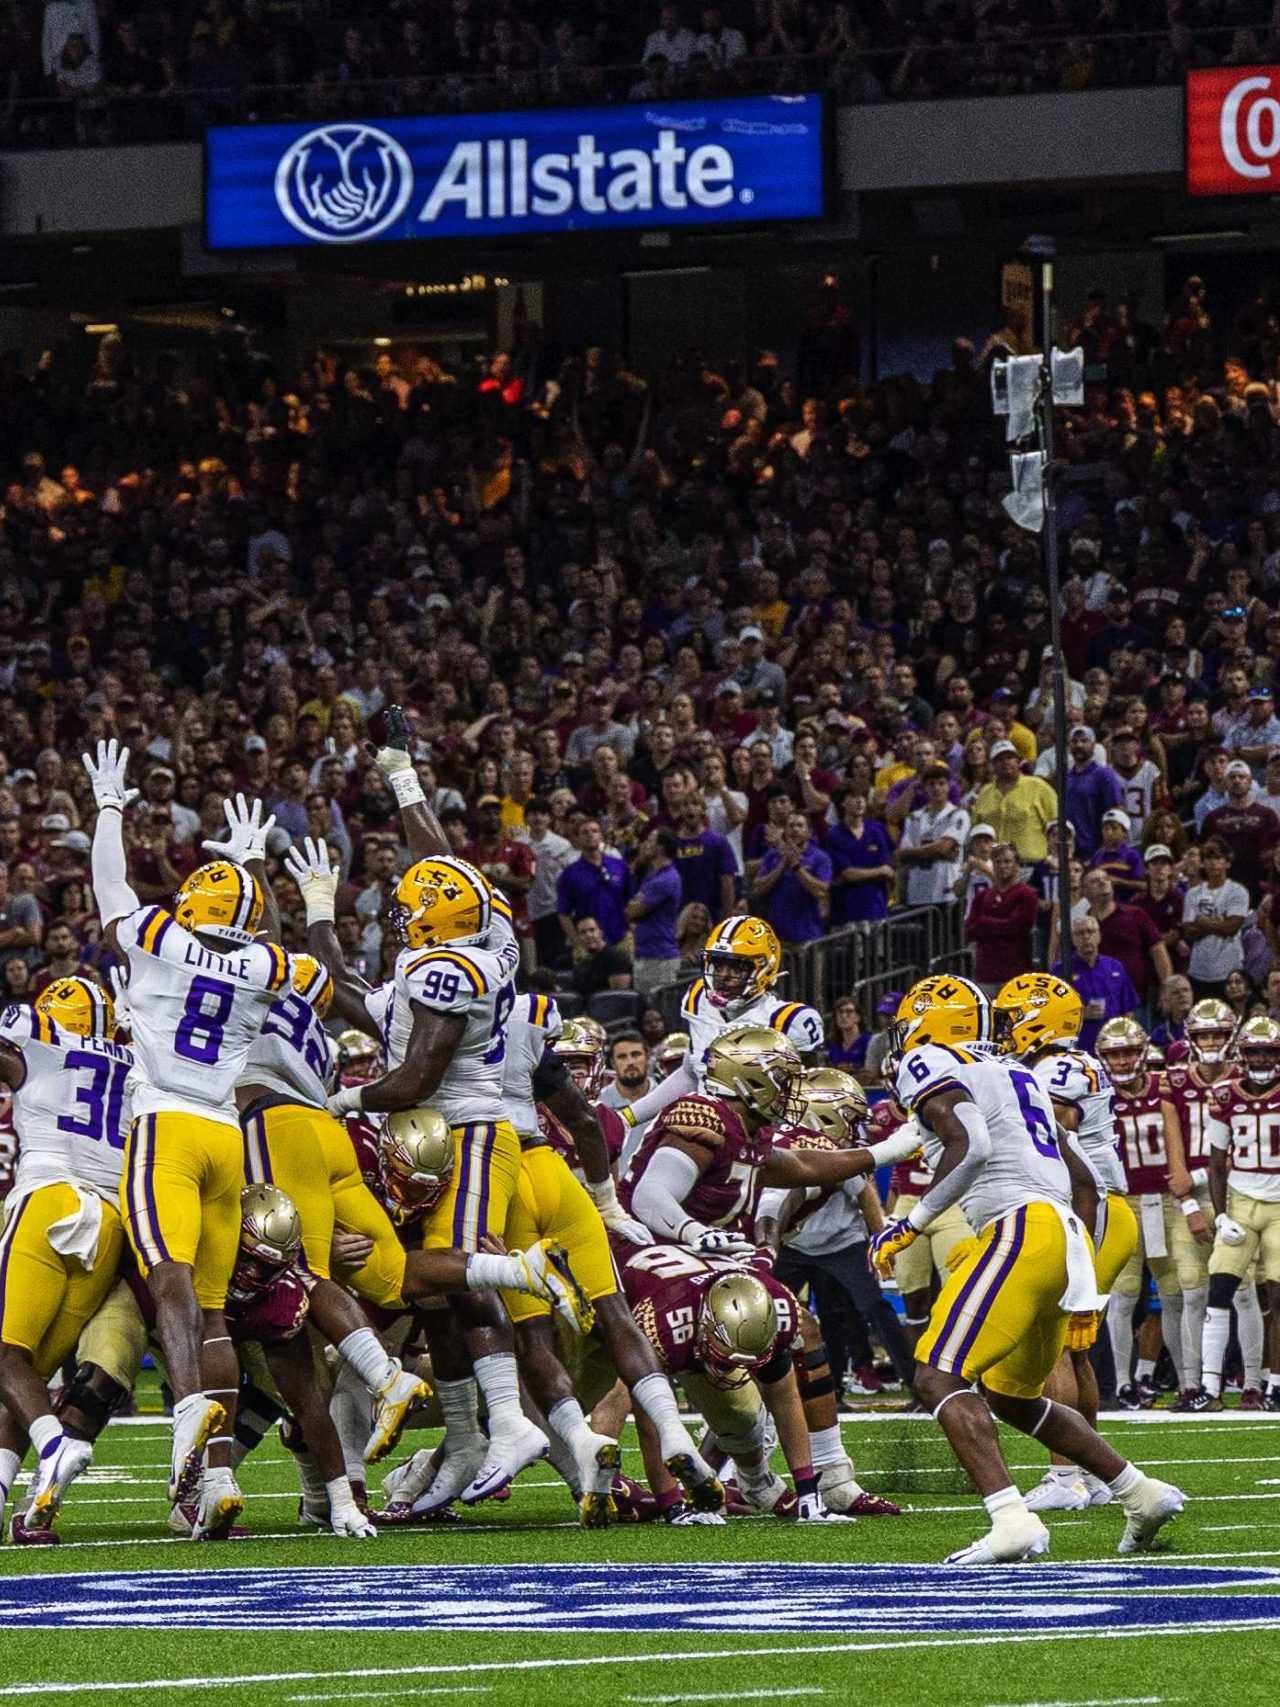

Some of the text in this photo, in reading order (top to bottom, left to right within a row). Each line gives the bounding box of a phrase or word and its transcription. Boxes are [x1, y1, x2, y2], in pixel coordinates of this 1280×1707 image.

[419, 130, 735, 222] Allstate
[184, 942, 251, 980] LITTLE
[422, 970, 460, 1003] 99
[175, 974, 235, 1065] 8
[907, 1054, 931, 1084] 6
[1051, 1060, 1072, 1087] 3
[1008, 1069, 1061, 1161] 6
[1120, 1112, 1168, 1169] 10
[1231, 1113, 1280, 1169] 80
[713, 1160, 761, 1227] 7
[665, 1306, 695, 1345] 56
